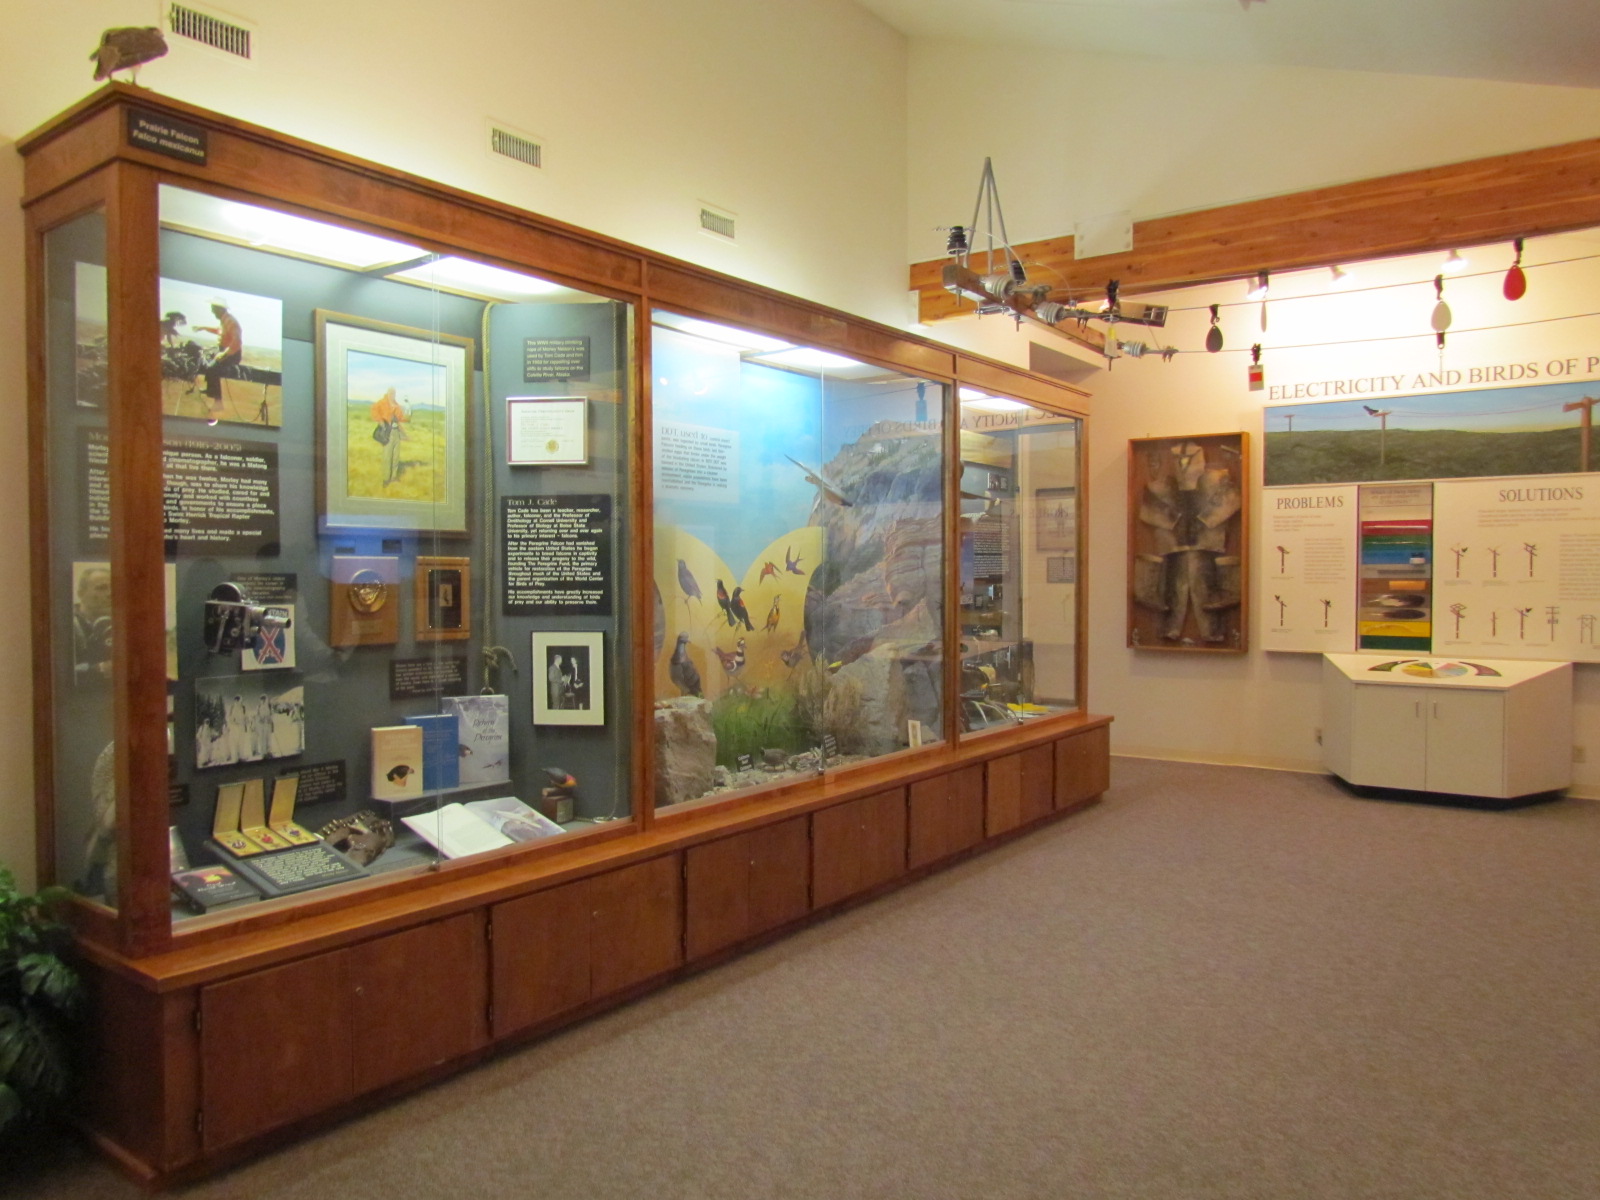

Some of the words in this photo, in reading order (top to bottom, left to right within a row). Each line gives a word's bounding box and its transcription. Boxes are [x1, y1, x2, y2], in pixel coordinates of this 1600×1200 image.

[133, 129, 158, 144] Falco
[159, 139, 204, 157] mexicanus
[139, 120, 169, 136] Prairie
[170, 129, 199, 145] Falcon
[1269, 375, 1405, 400] ELECTRICITY
[1412, 370, 1461, 389] AND
[1468, 362, 1539, 384] BIRDS
[1546, 358, 1578, 377] OF
[537, 498, 557, 506] Cade
[1276, 496, 1344, 510] PROBLEMS
[1499, 486, 1584, 503] SOLUTIONS
